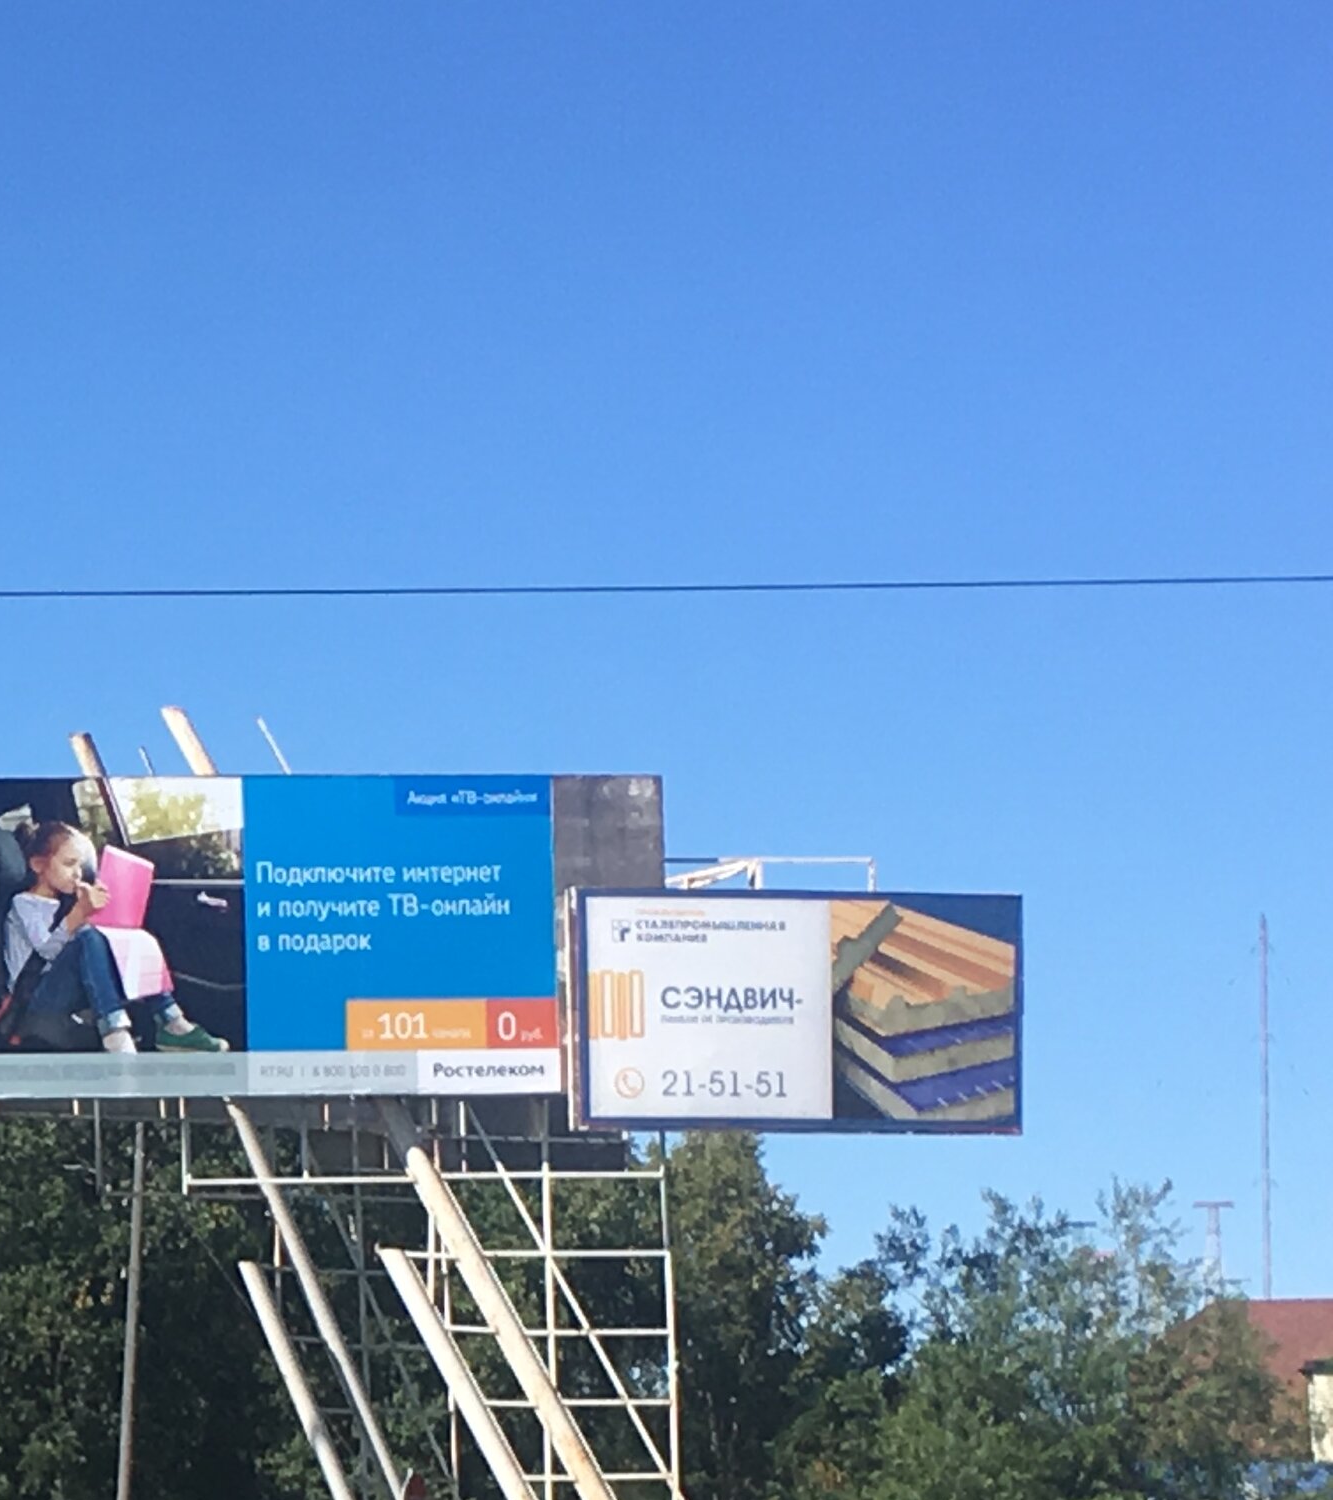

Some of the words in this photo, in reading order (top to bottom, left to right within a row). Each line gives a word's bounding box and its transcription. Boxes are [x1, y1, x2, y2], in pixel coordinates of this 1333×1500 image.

[256, 861, 395, 887] Подключите
[402, 864, 502, 887] интернет
[256, 900, 271, 918] и
[278, 898, 381, 922] получите
[387, 892, 511, 918] ТВ-онлайн
[256, 935, 270, 952] в
[278, 933, 372, 955] подарок
[636, 932, 708, 944] КОМПАНИЯ
[660, 985, 804, 1014] СЭНДВИЧ-
[377, 1011, 427, 1040] 101
[497, 1011, 517, 1041] 0
[432, 1062, 546, 1079] Ростелеком
[661, 1069, 789, 1099] 21-51-51
